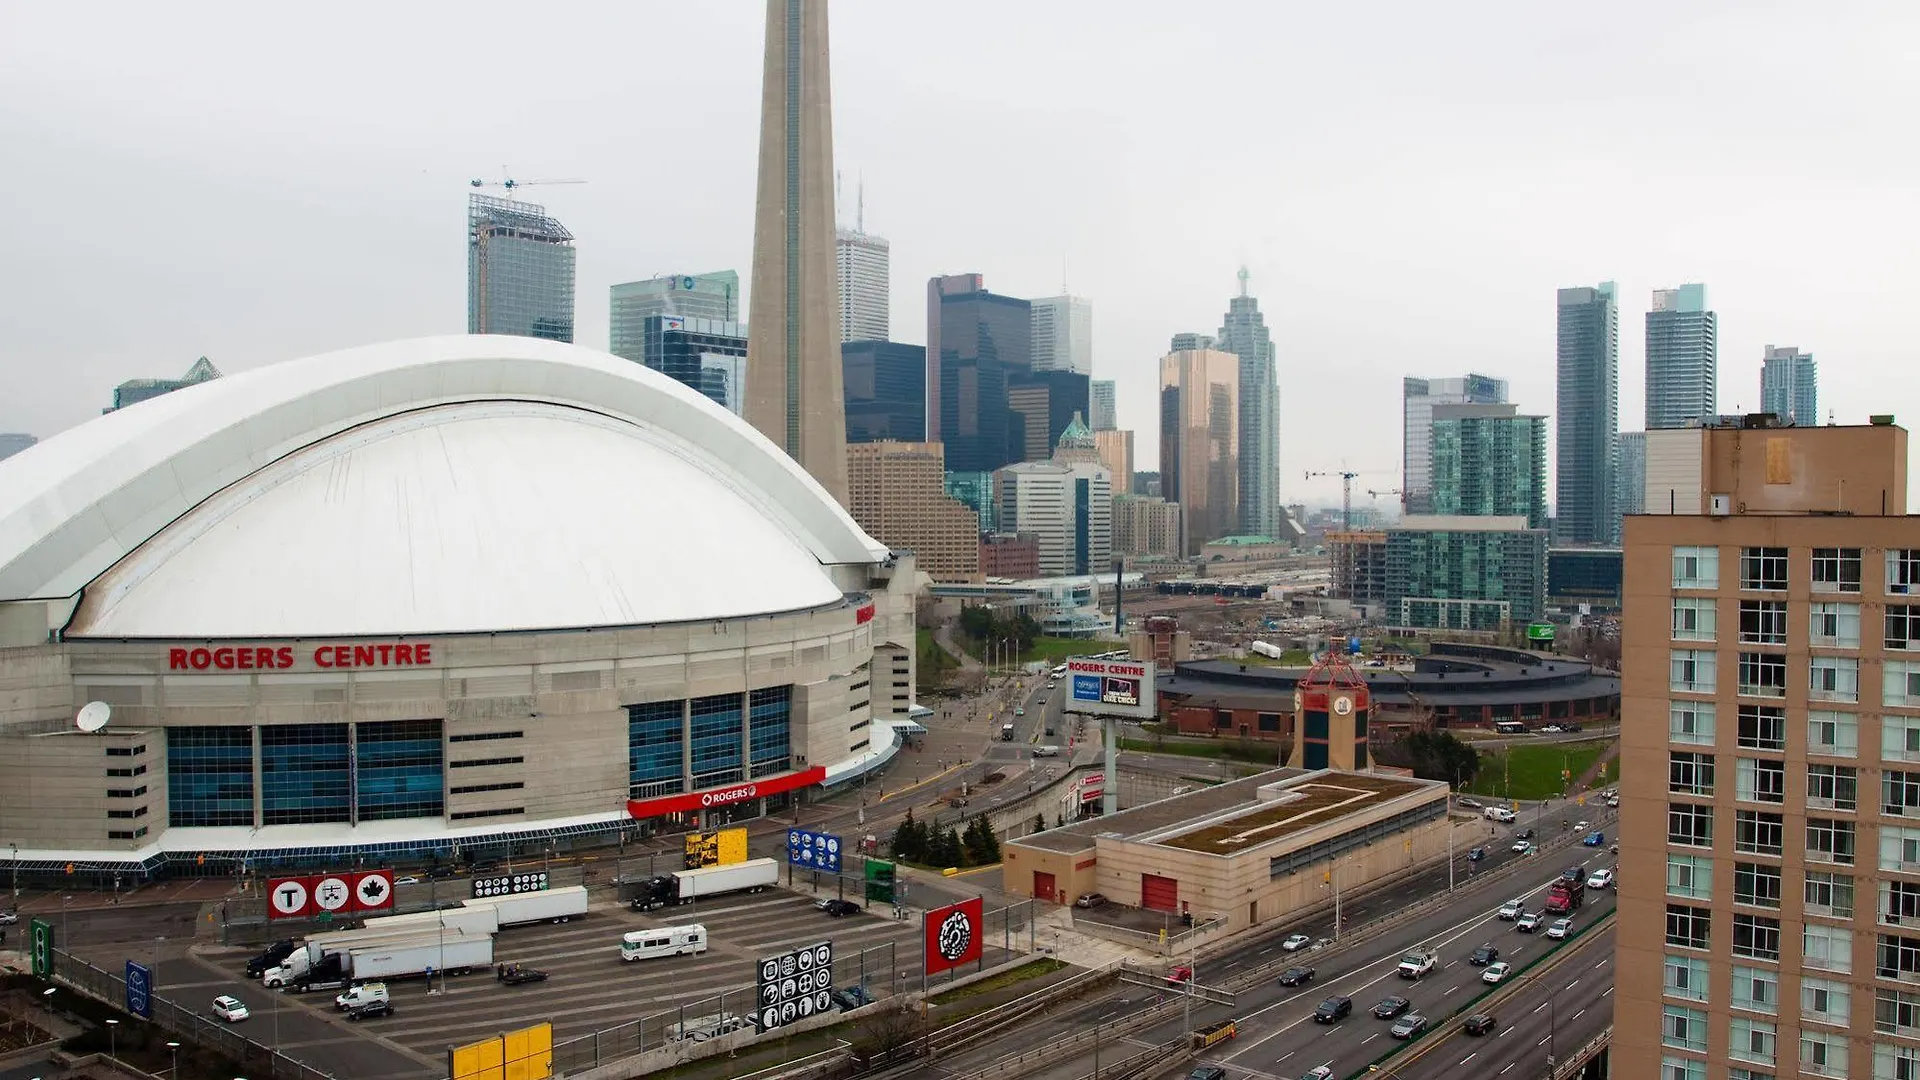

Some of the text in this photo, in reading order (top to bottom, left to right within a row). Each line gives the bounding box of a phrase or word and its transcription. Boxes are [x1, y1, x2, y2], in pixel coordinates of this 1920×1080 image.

[170, 644, 431, 669] ROGERS CENTRE
[1069, 662, 1144, 676] ROGERS CENTRE
[713, 788, 748, 803] ROGERS
